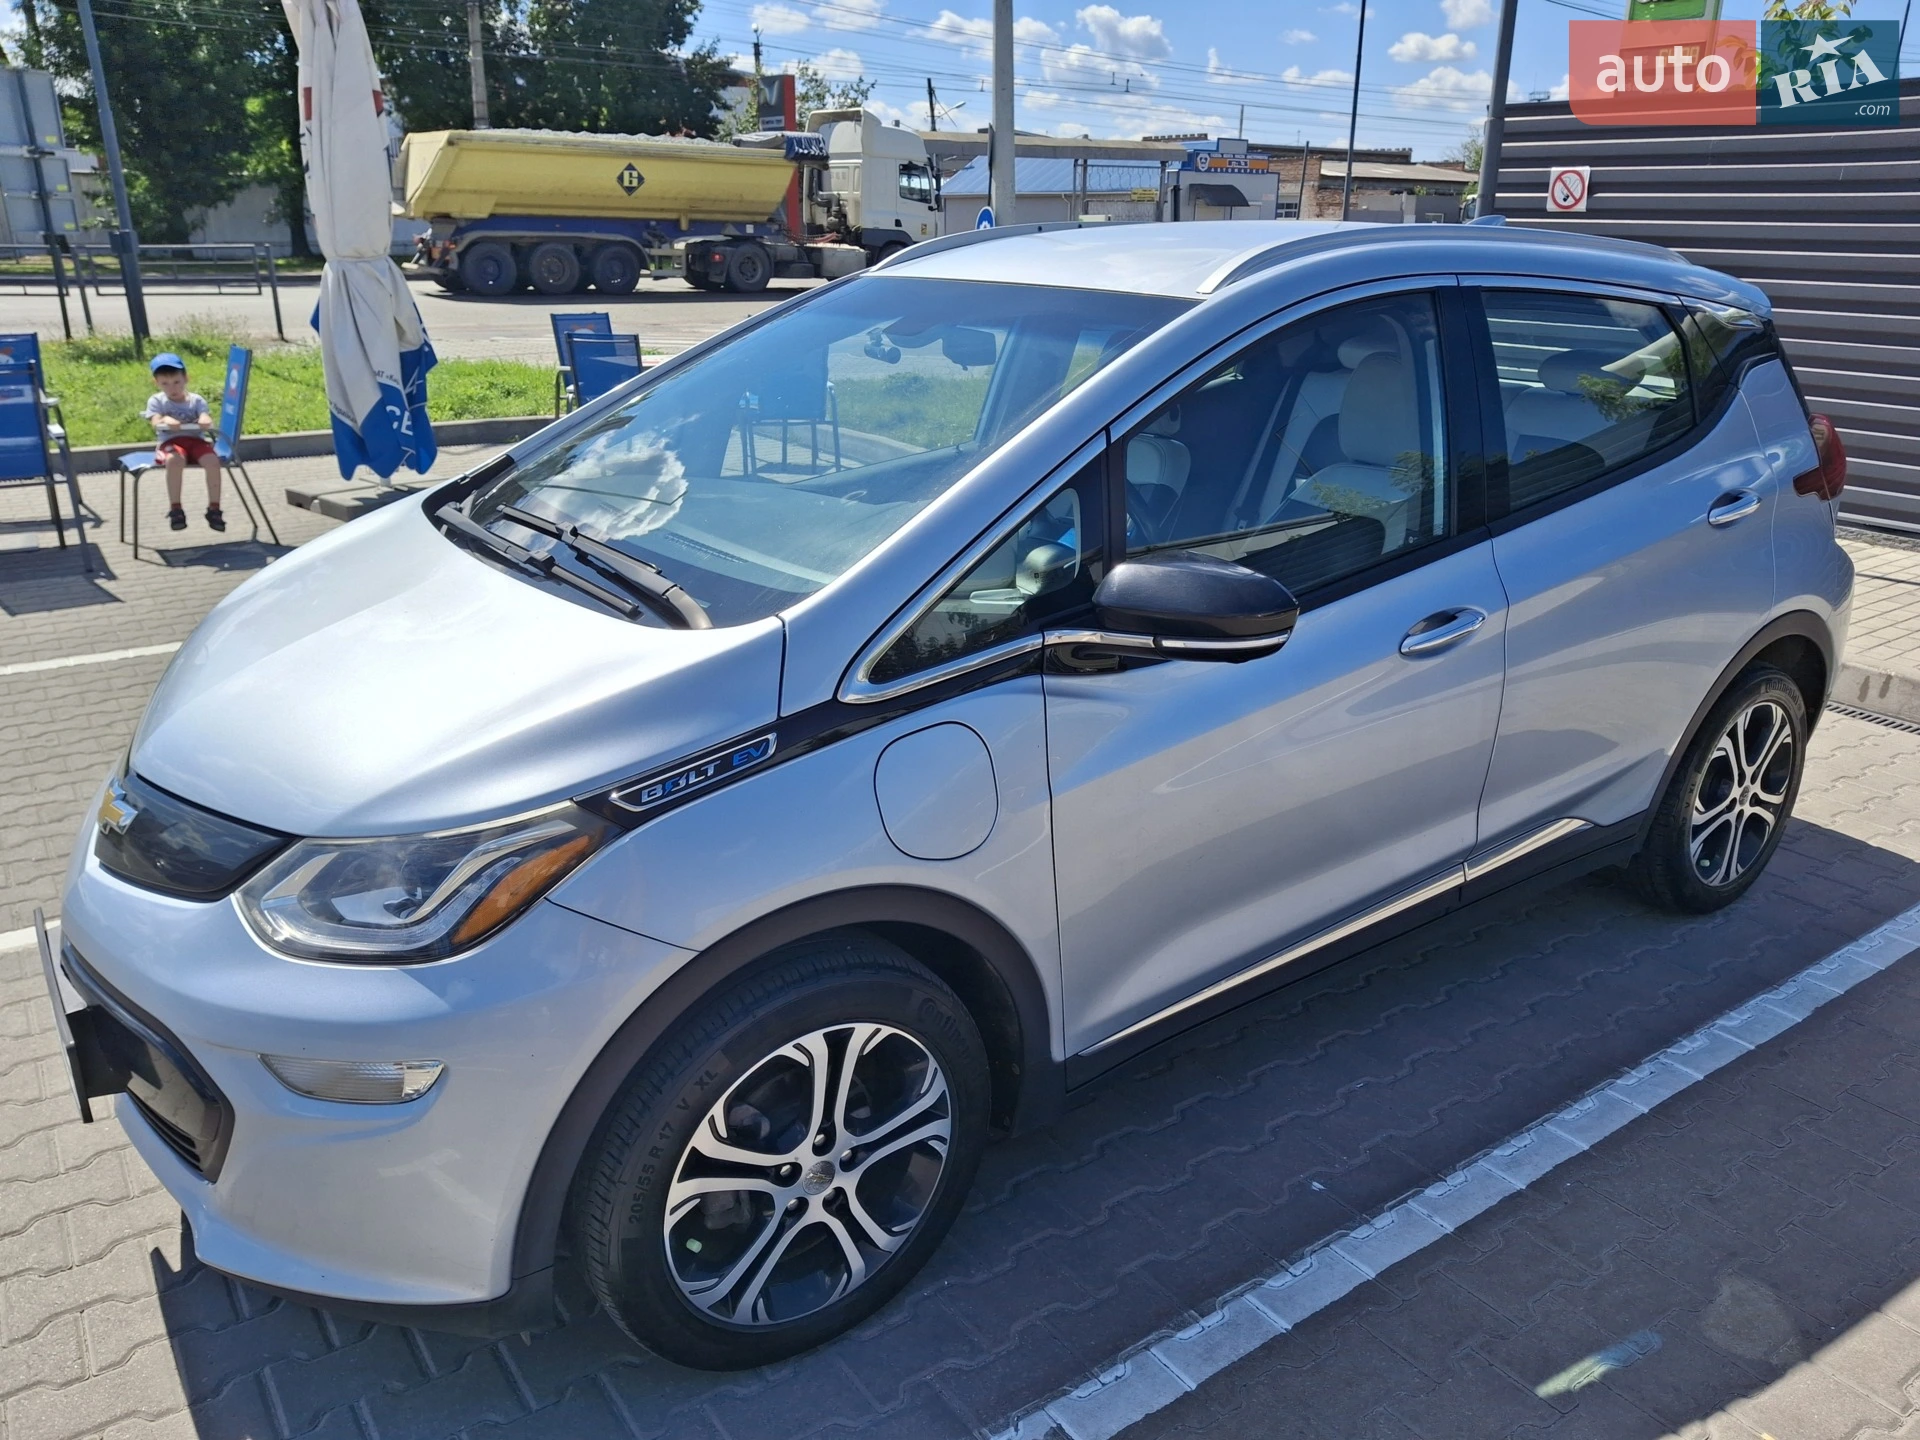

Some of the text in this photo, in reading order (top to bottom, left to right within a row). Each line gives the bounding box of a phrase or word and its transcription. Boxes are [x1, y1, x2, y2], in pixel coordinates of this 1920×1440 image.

[641, 742, 767, 803] BOLT EV
[629, 1069, 719, 1224] 205/55 R 17 V XL
